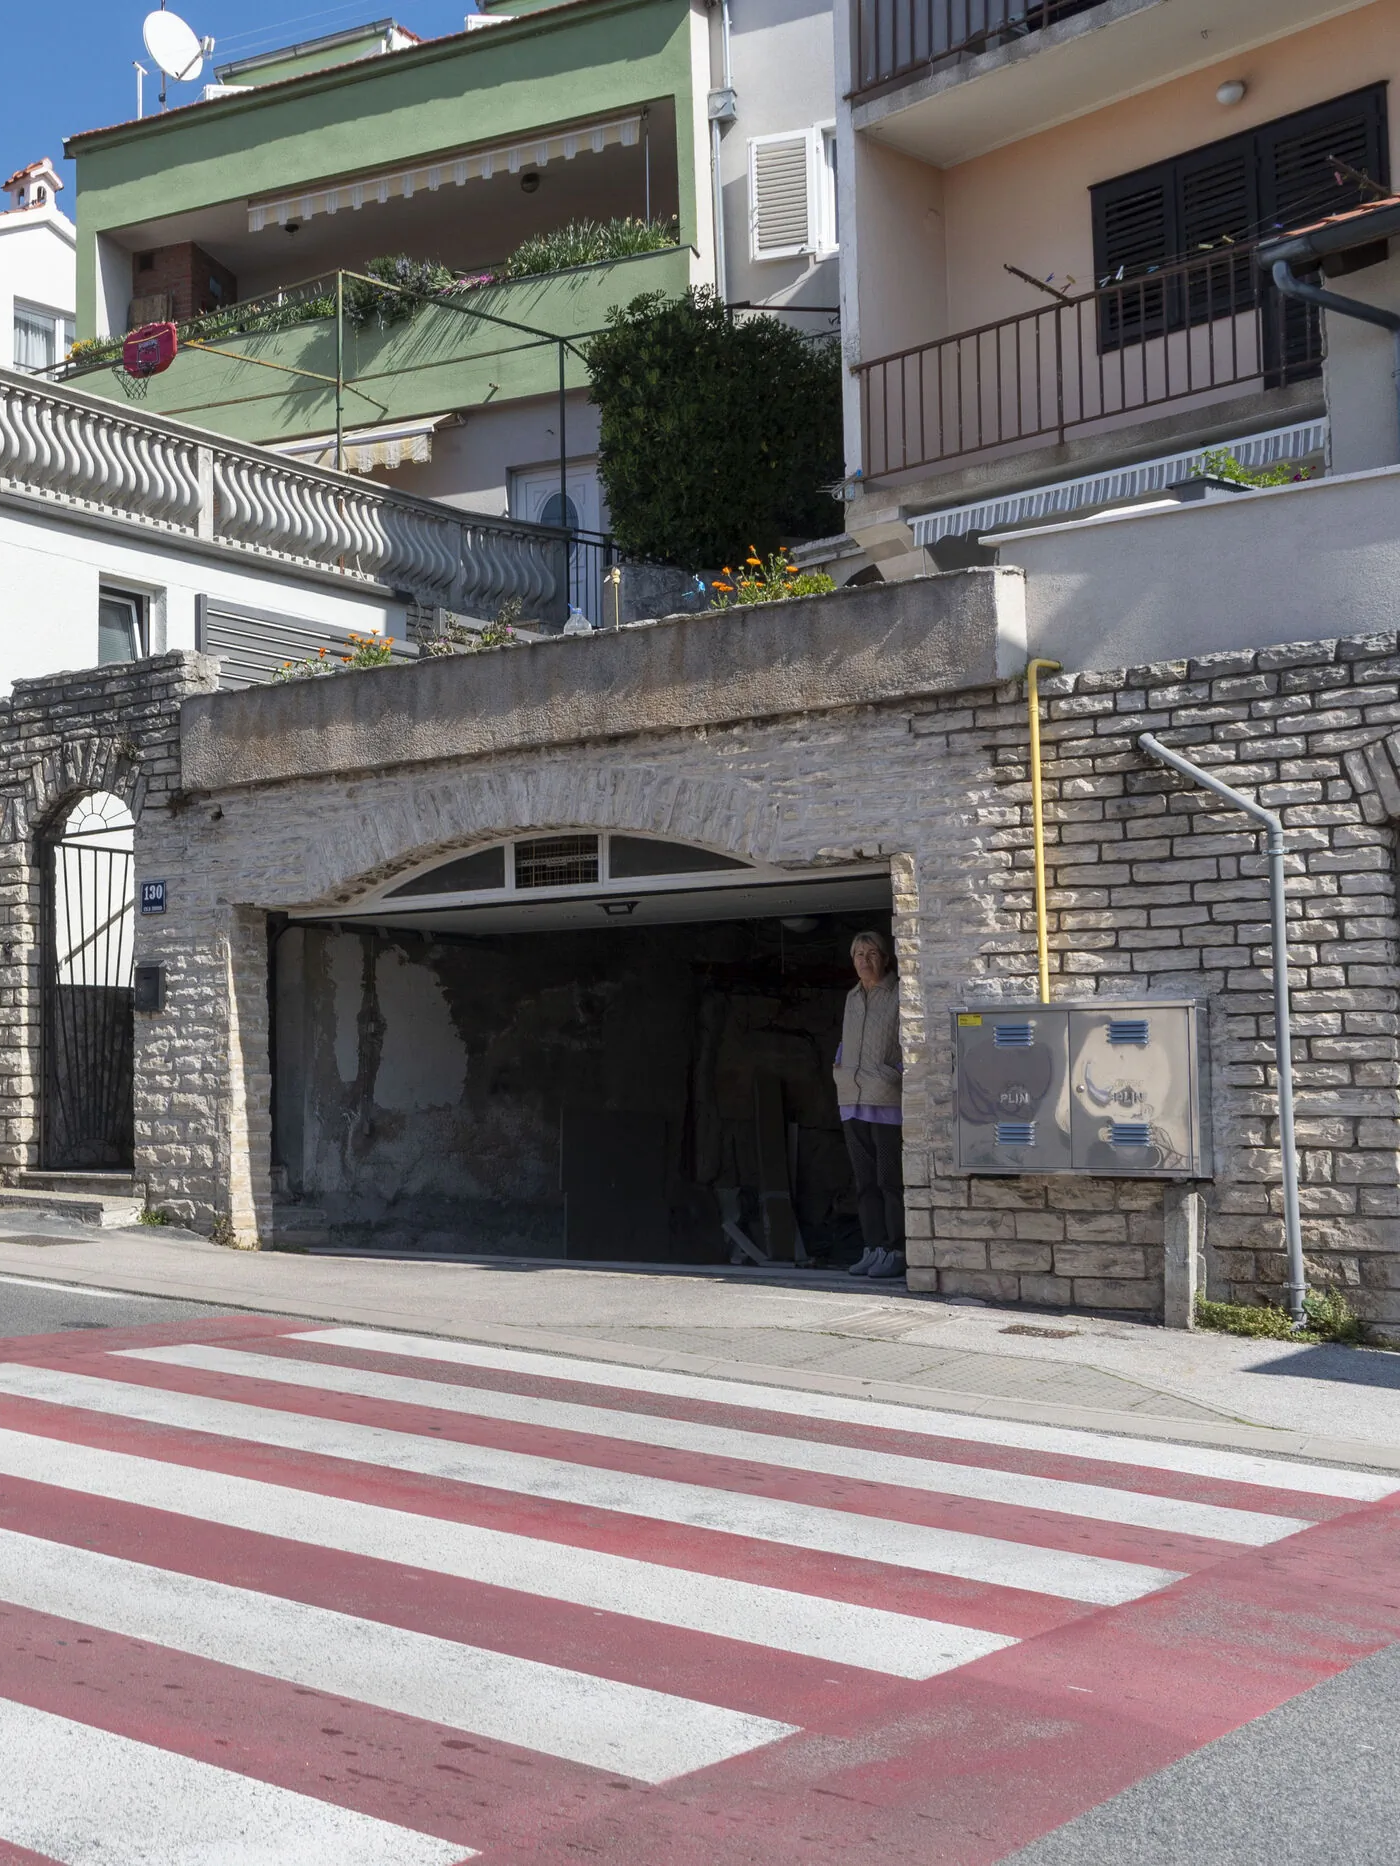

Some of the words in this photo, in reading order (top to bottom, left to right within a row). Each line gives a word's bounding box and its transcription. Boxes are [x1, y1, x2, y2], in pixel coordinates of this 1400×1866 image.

[144, 885, 163, 900] 130
[1000, 1092, 1030, 1104] PLIN
[1113, 1091, 1144, 1104] PLIN
